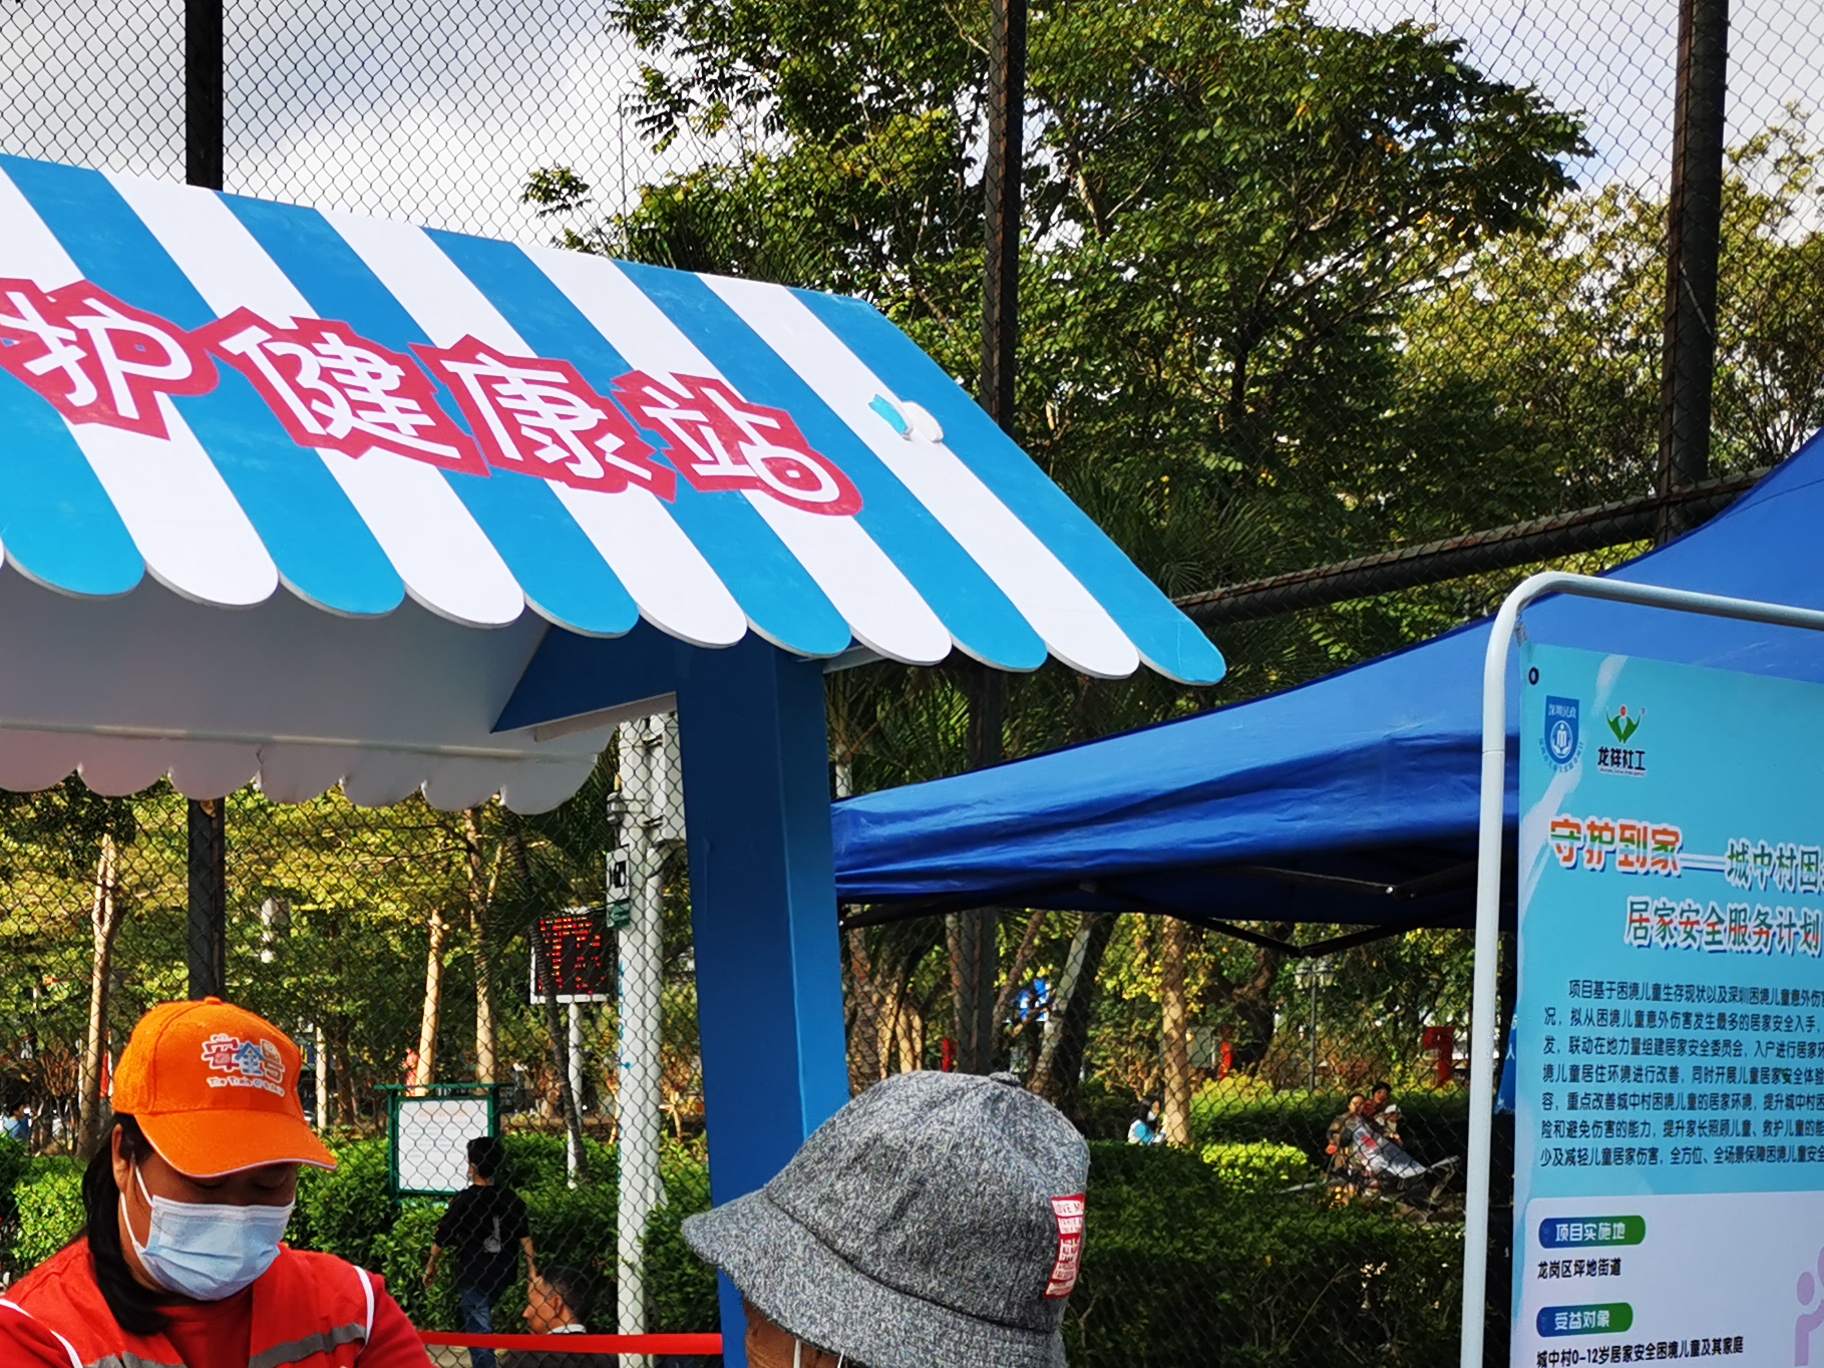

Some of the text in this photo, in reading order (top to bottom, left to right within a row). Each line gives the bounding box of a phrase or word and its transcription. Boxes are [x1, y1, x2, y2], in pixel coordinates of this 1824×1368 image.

[1598, 746, 1646, 771] 龙祥社工
[1549, 817, 1824, 890] 守护到家——城中村困
[1627, 899, 1821, 951] 居家安全服务计划
[1555, 1221, 1626, 1242] 项目实施地
[1537, 1257, 1622, 1280] 龙岗区坪地街道
[1554, 1310, 1610, 1331] 受益对象
